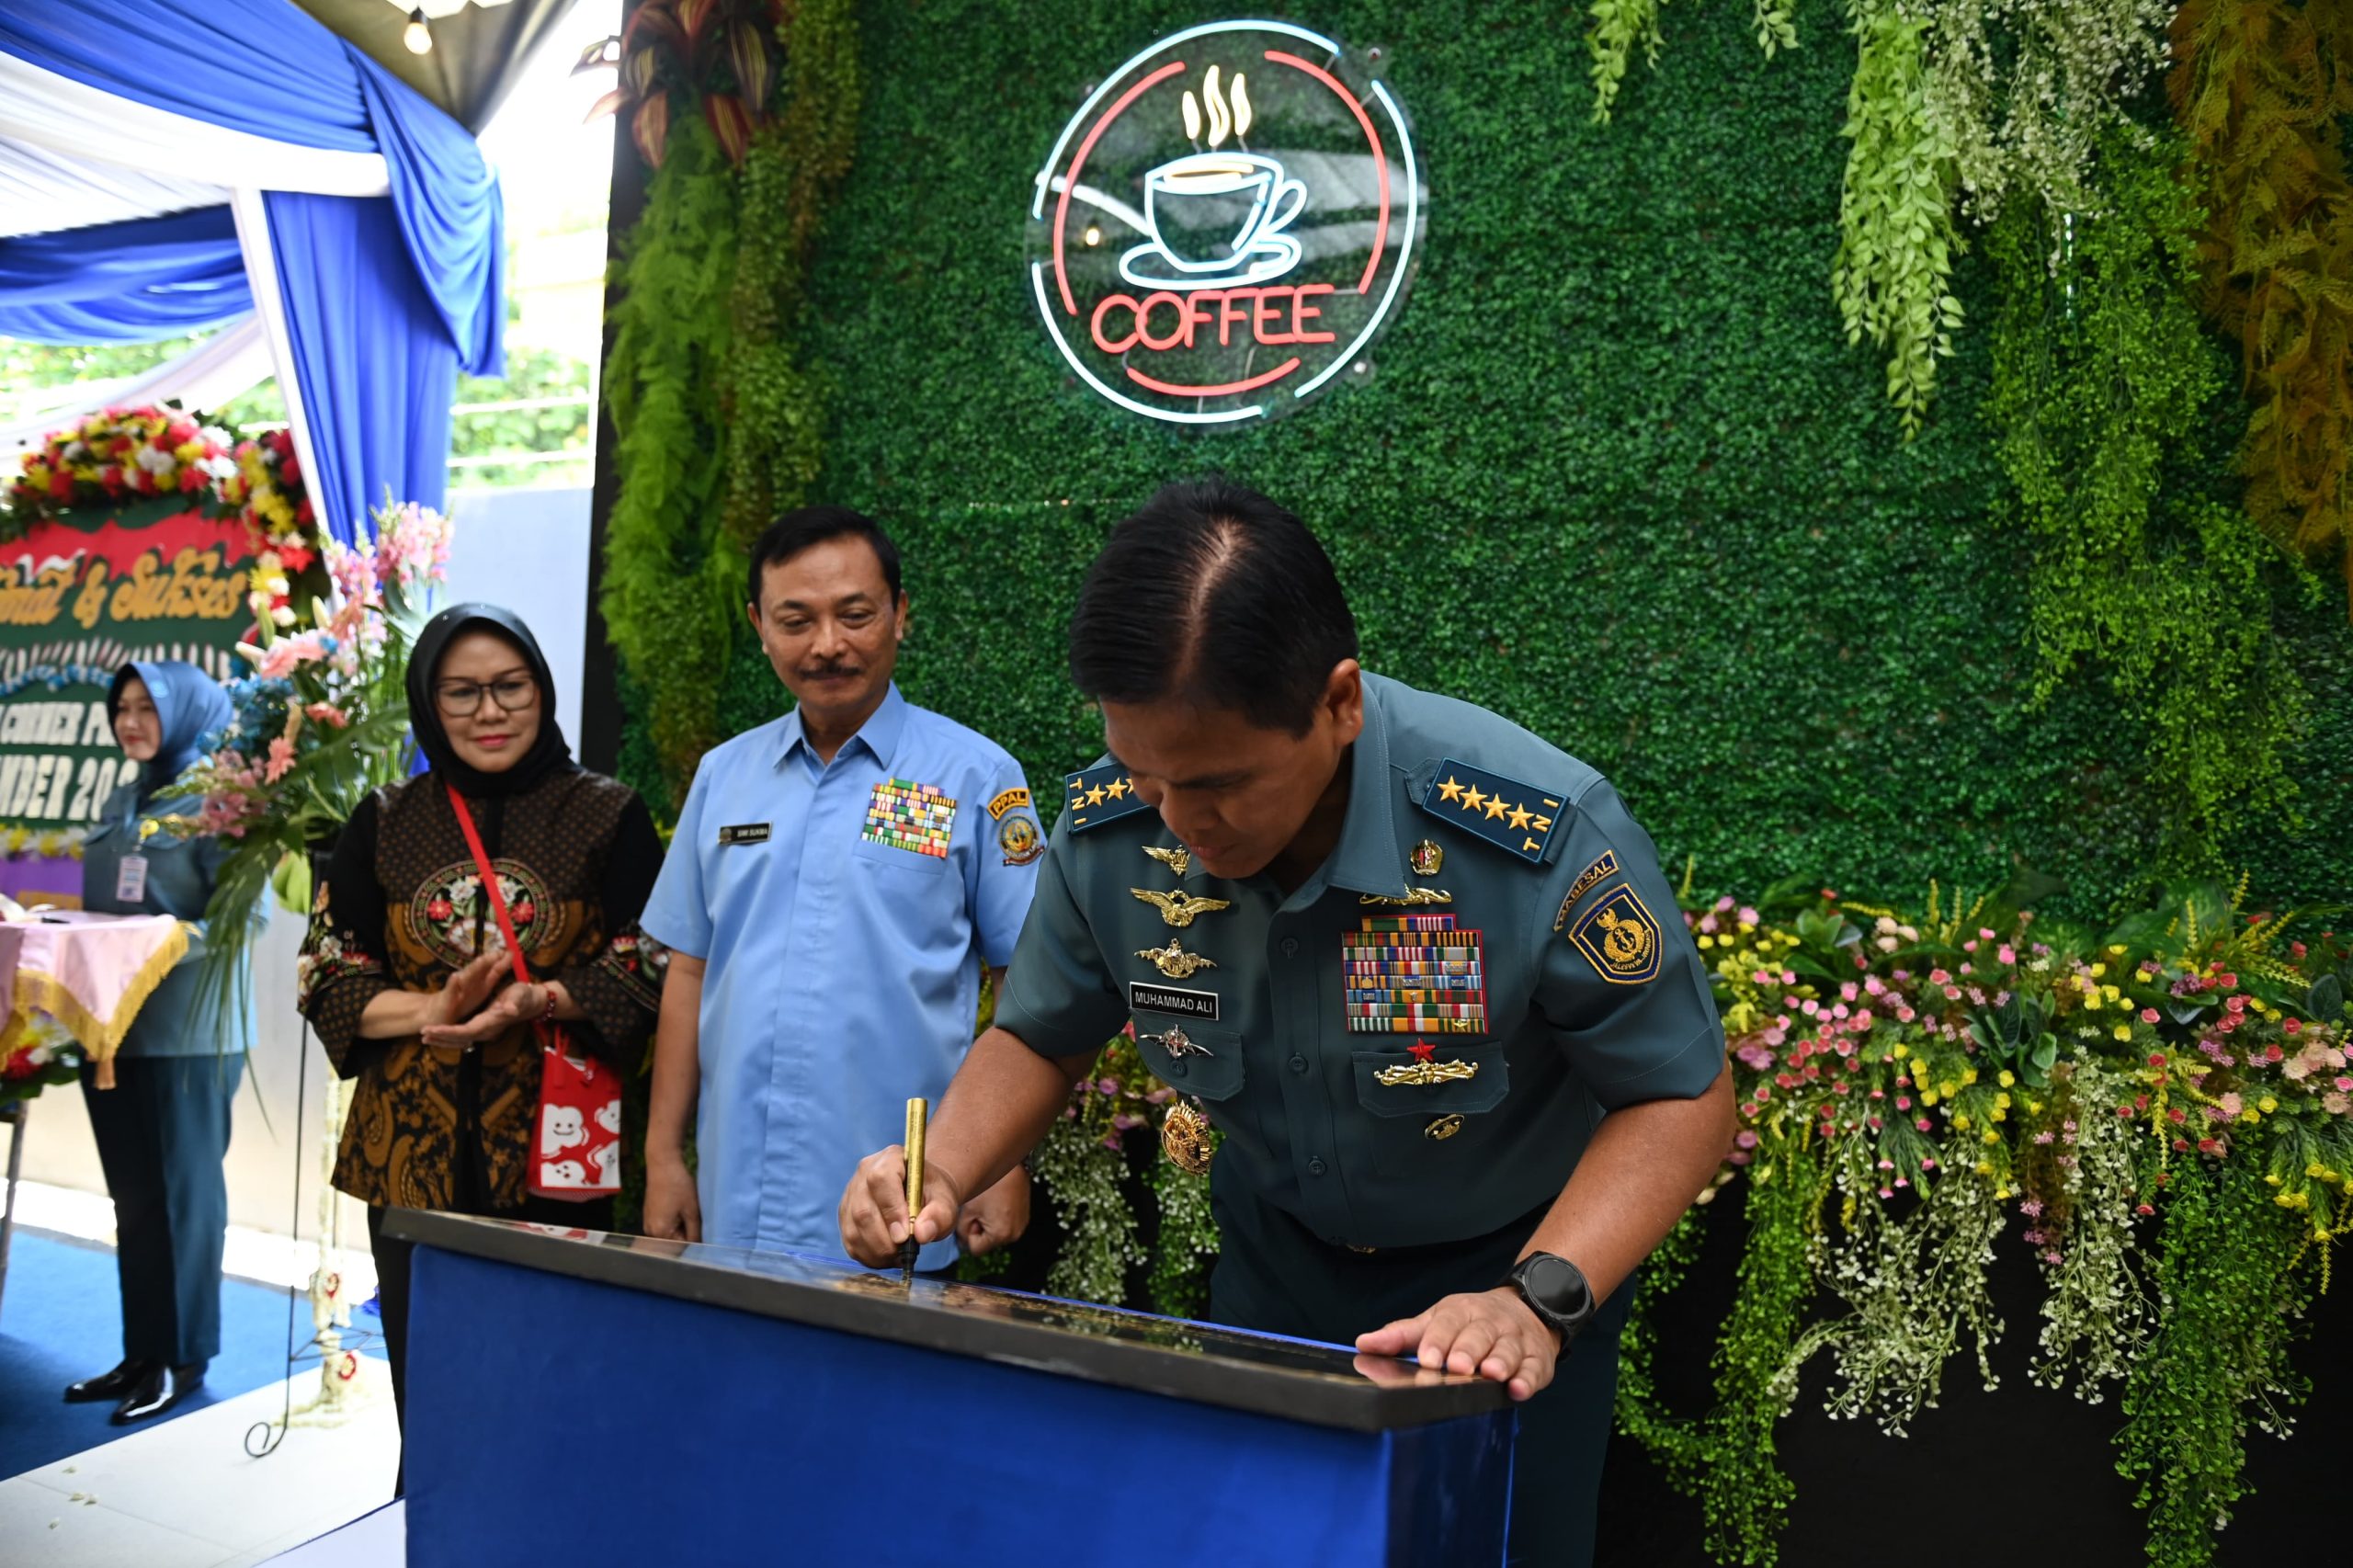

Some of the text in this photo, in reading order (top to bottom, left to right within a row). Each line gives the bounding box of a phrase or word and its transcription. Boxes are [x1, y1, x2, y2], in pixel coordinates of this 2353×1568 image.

[1091, 284, 1336, 354] COFFEE
[109, 547, 246, 621] Sukses
[993, 792, 1026, 813] PPAL
[1069, 778, 1086, 824] TNI
[1522, 799, 1559, 851] TNI
[1135, 992, 1212, 1013] MUHAMMAD ALI
